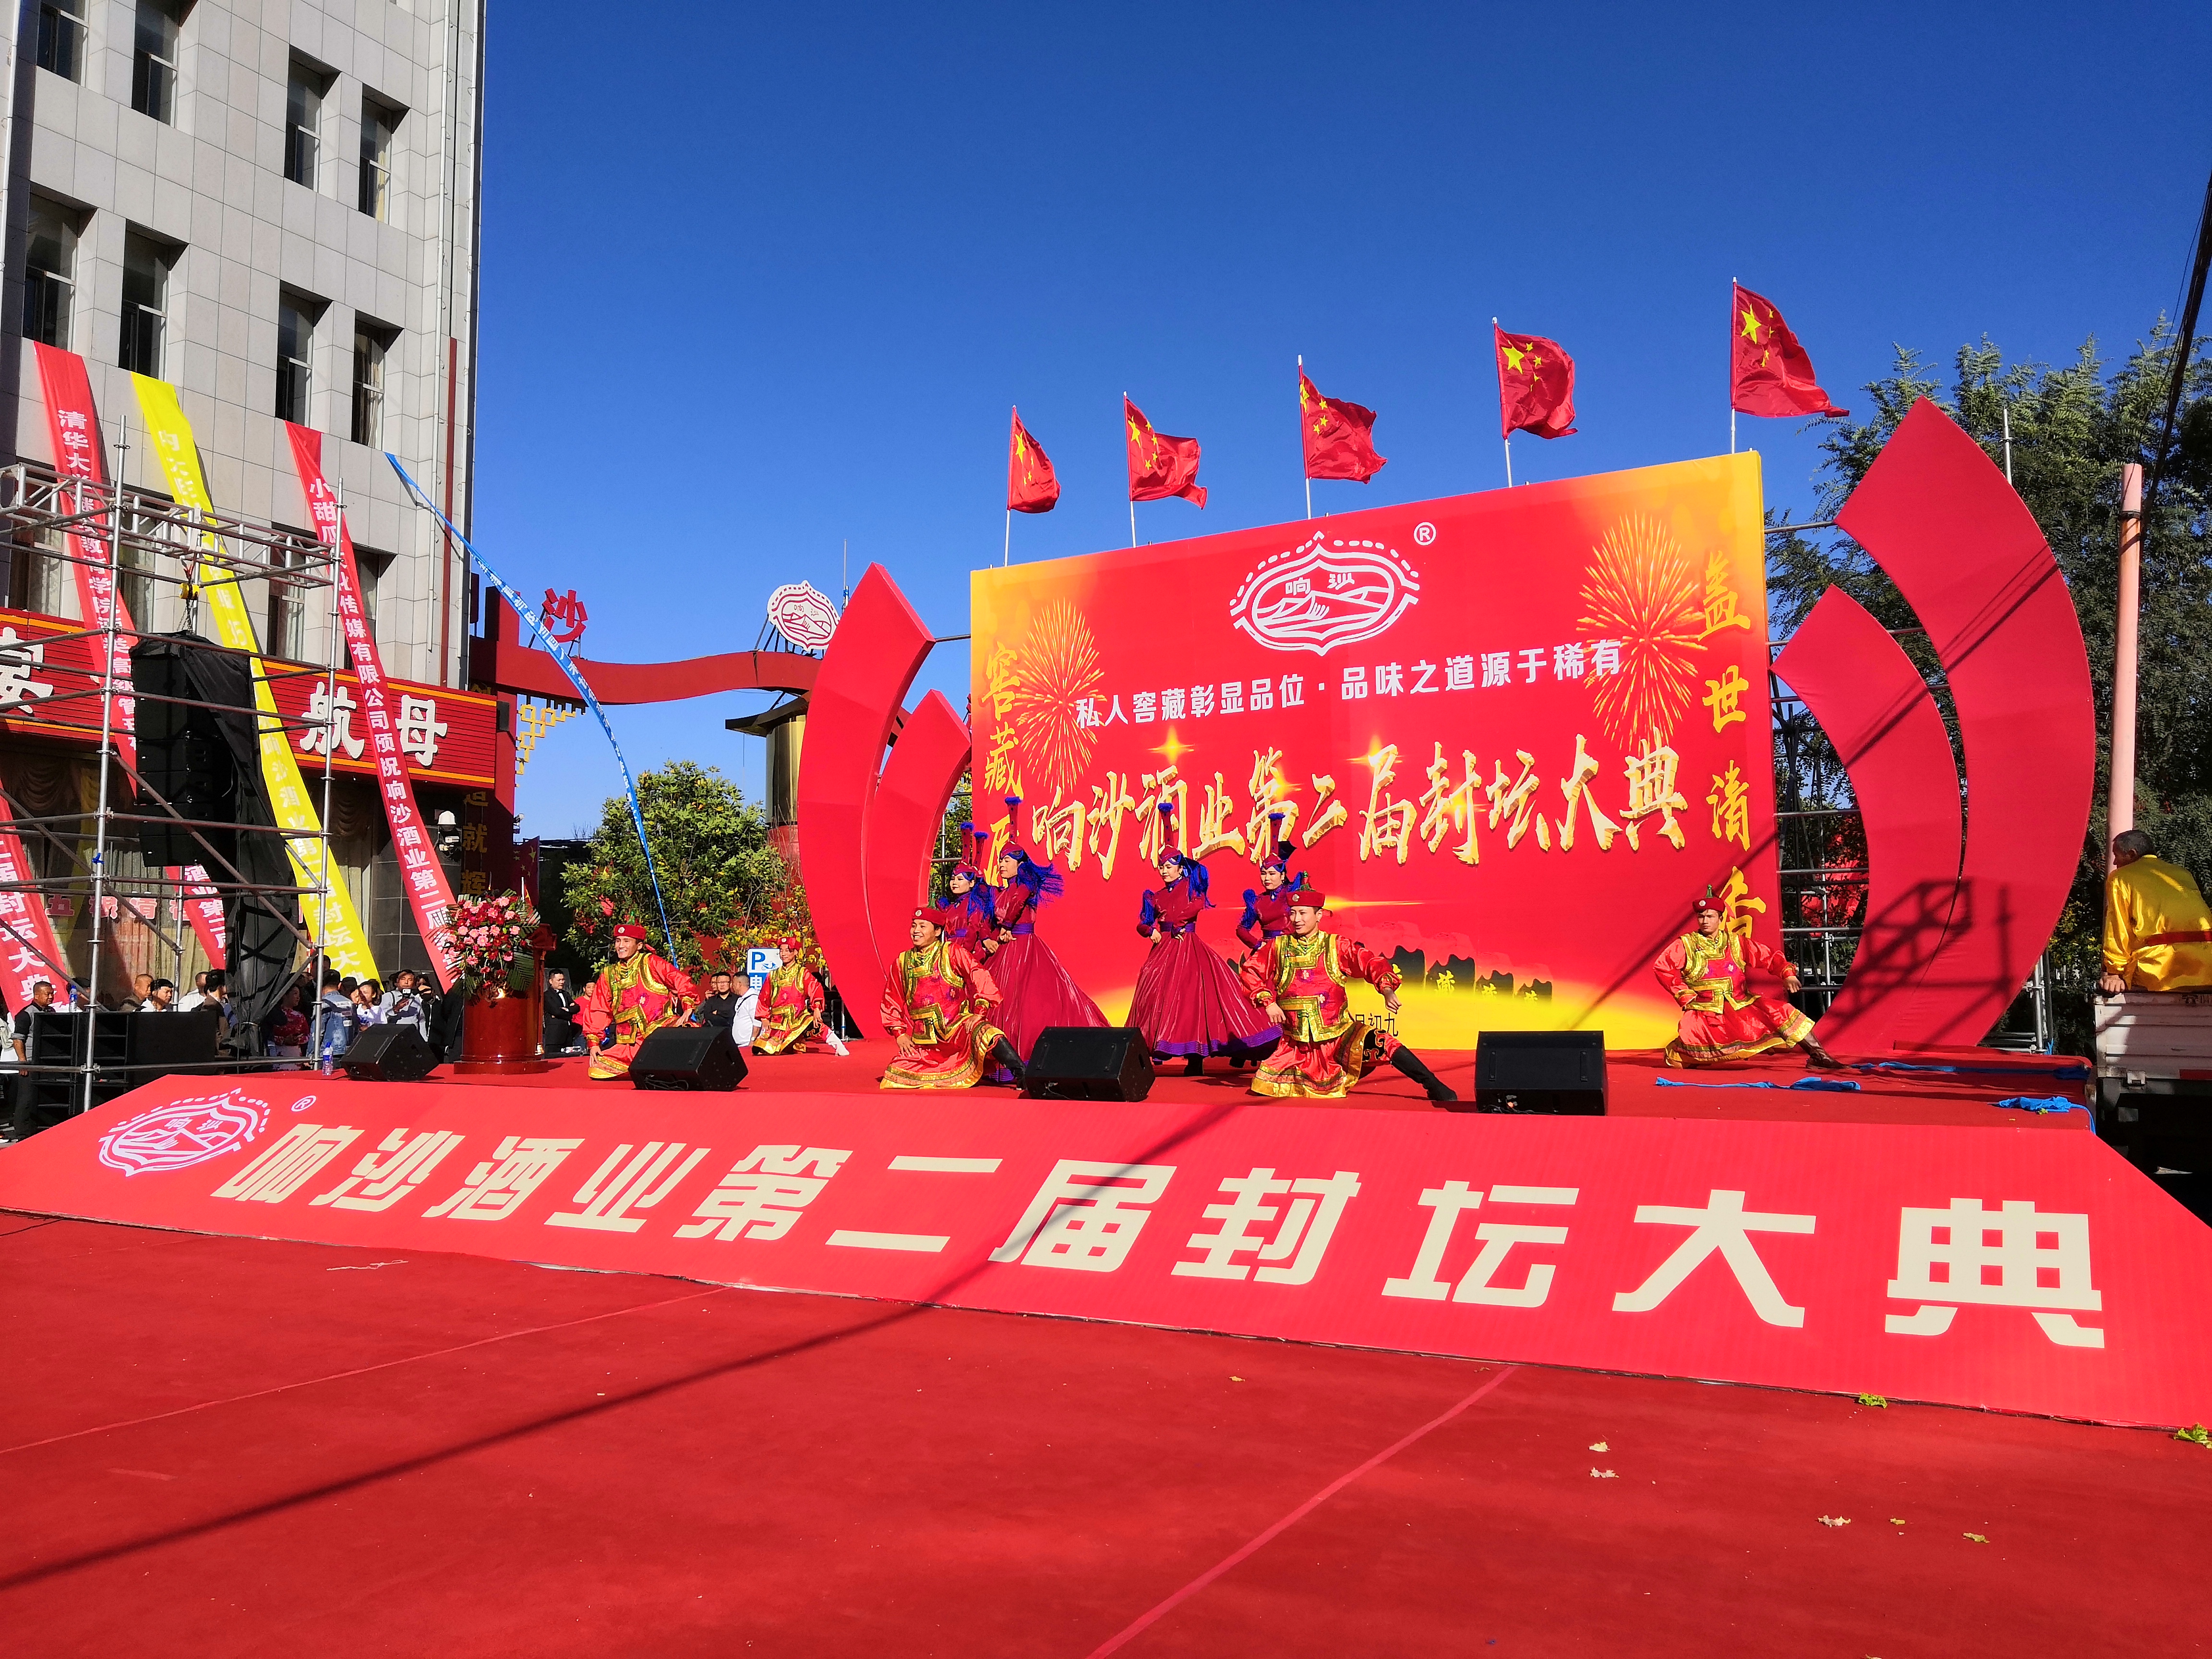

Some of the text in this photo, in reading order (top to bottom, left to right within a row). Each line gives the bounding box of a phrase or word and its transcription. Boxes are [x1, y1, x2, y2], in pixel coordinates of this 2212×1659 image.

[1285, 573, 1355, 595] 响沙
[1032, 726, 1687, 880] 响沙酒业第二届封坛大典
[752, 951, 766, 970] P
[211, 1123, 2104, 1349] 响沙酒业第二届封坛大典
